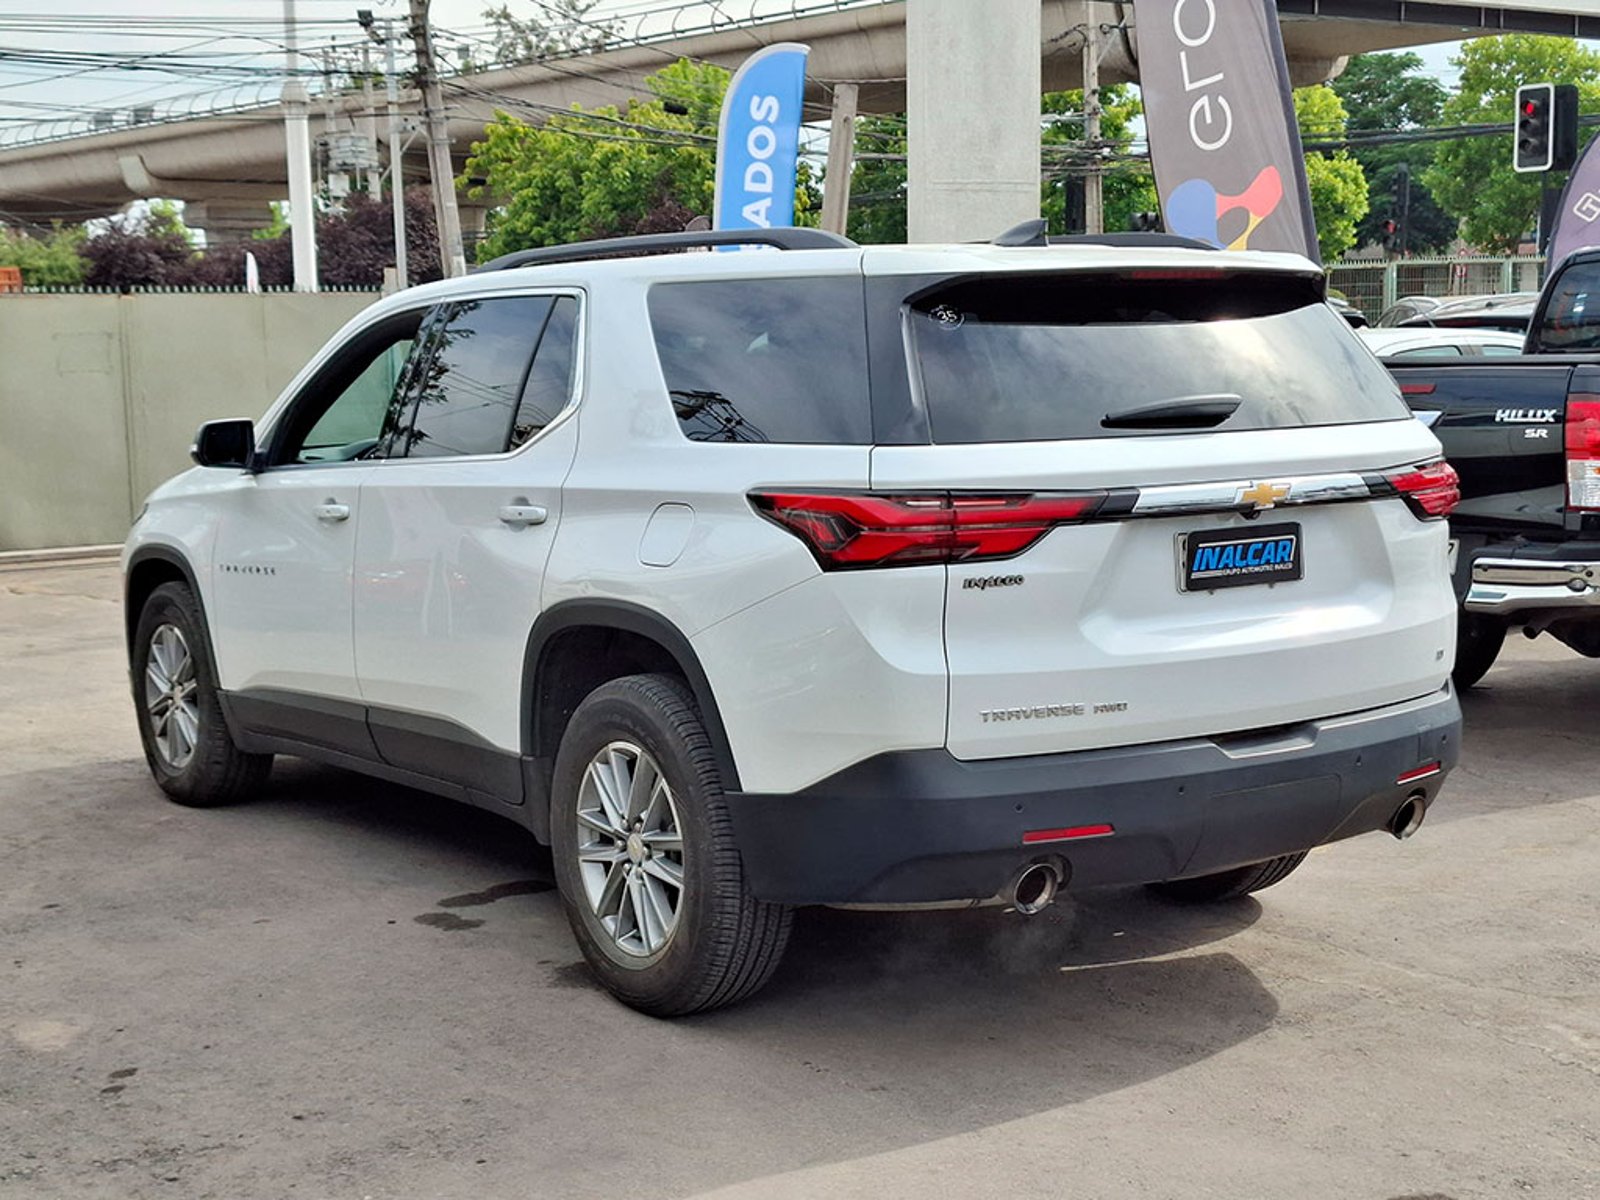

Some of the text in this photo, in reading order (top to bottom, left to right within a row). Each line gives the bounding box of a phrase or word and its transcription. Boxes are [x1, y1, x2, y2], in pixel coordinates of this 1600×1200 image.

[741, 94, 780, 250] ADOS
[1494, 408, 1557, 423] HILUX
[1523, 427, 1549, 439] SR
[1191, 539, 1293, 572] INALCAR
[979, 701, 1086, 723] TRAVERSE
